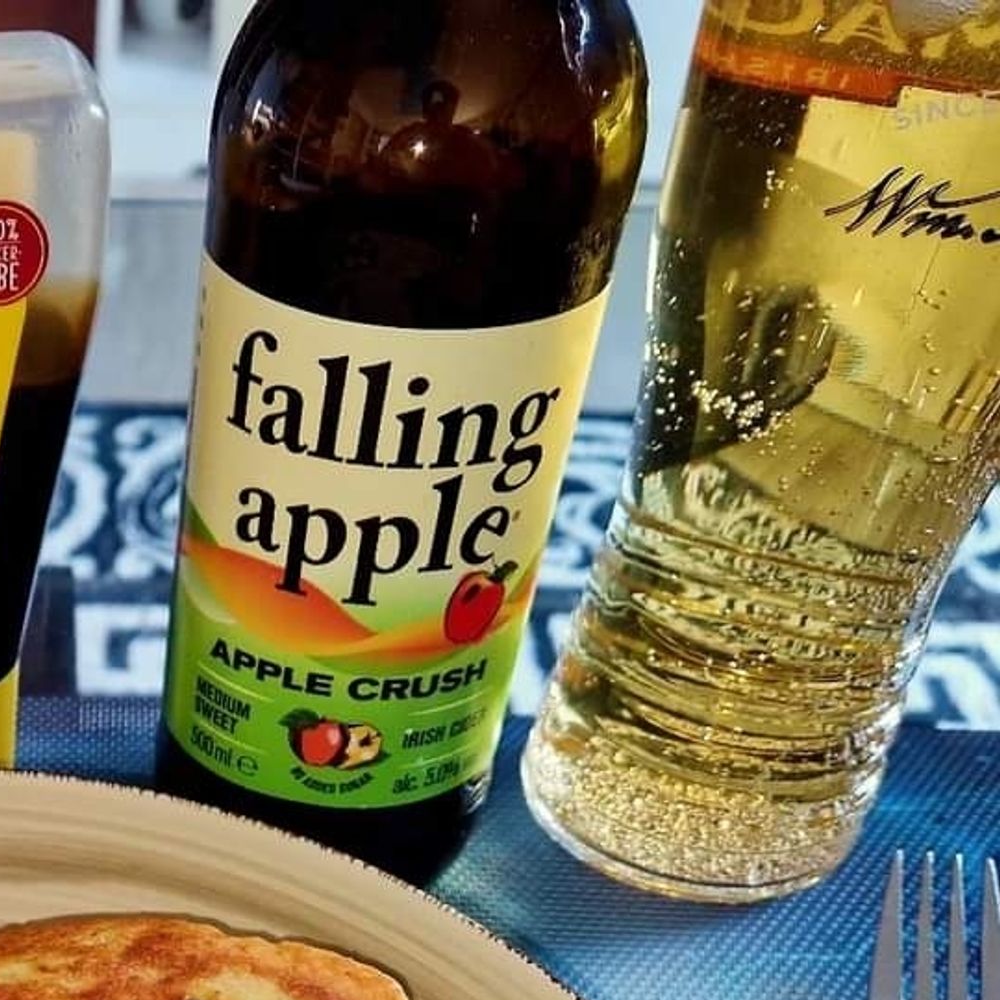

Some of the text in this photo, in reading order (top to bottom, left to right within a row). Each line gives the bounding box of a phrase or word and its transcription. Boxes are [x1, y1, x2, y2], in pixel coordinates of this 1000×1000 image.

[226, 330, 562, 494] falling
[235, 474, 512, 607] apple
[196, 675, 252, 721] MEDIUM
[210, 640, 488, 701] APPLE CRUSH
